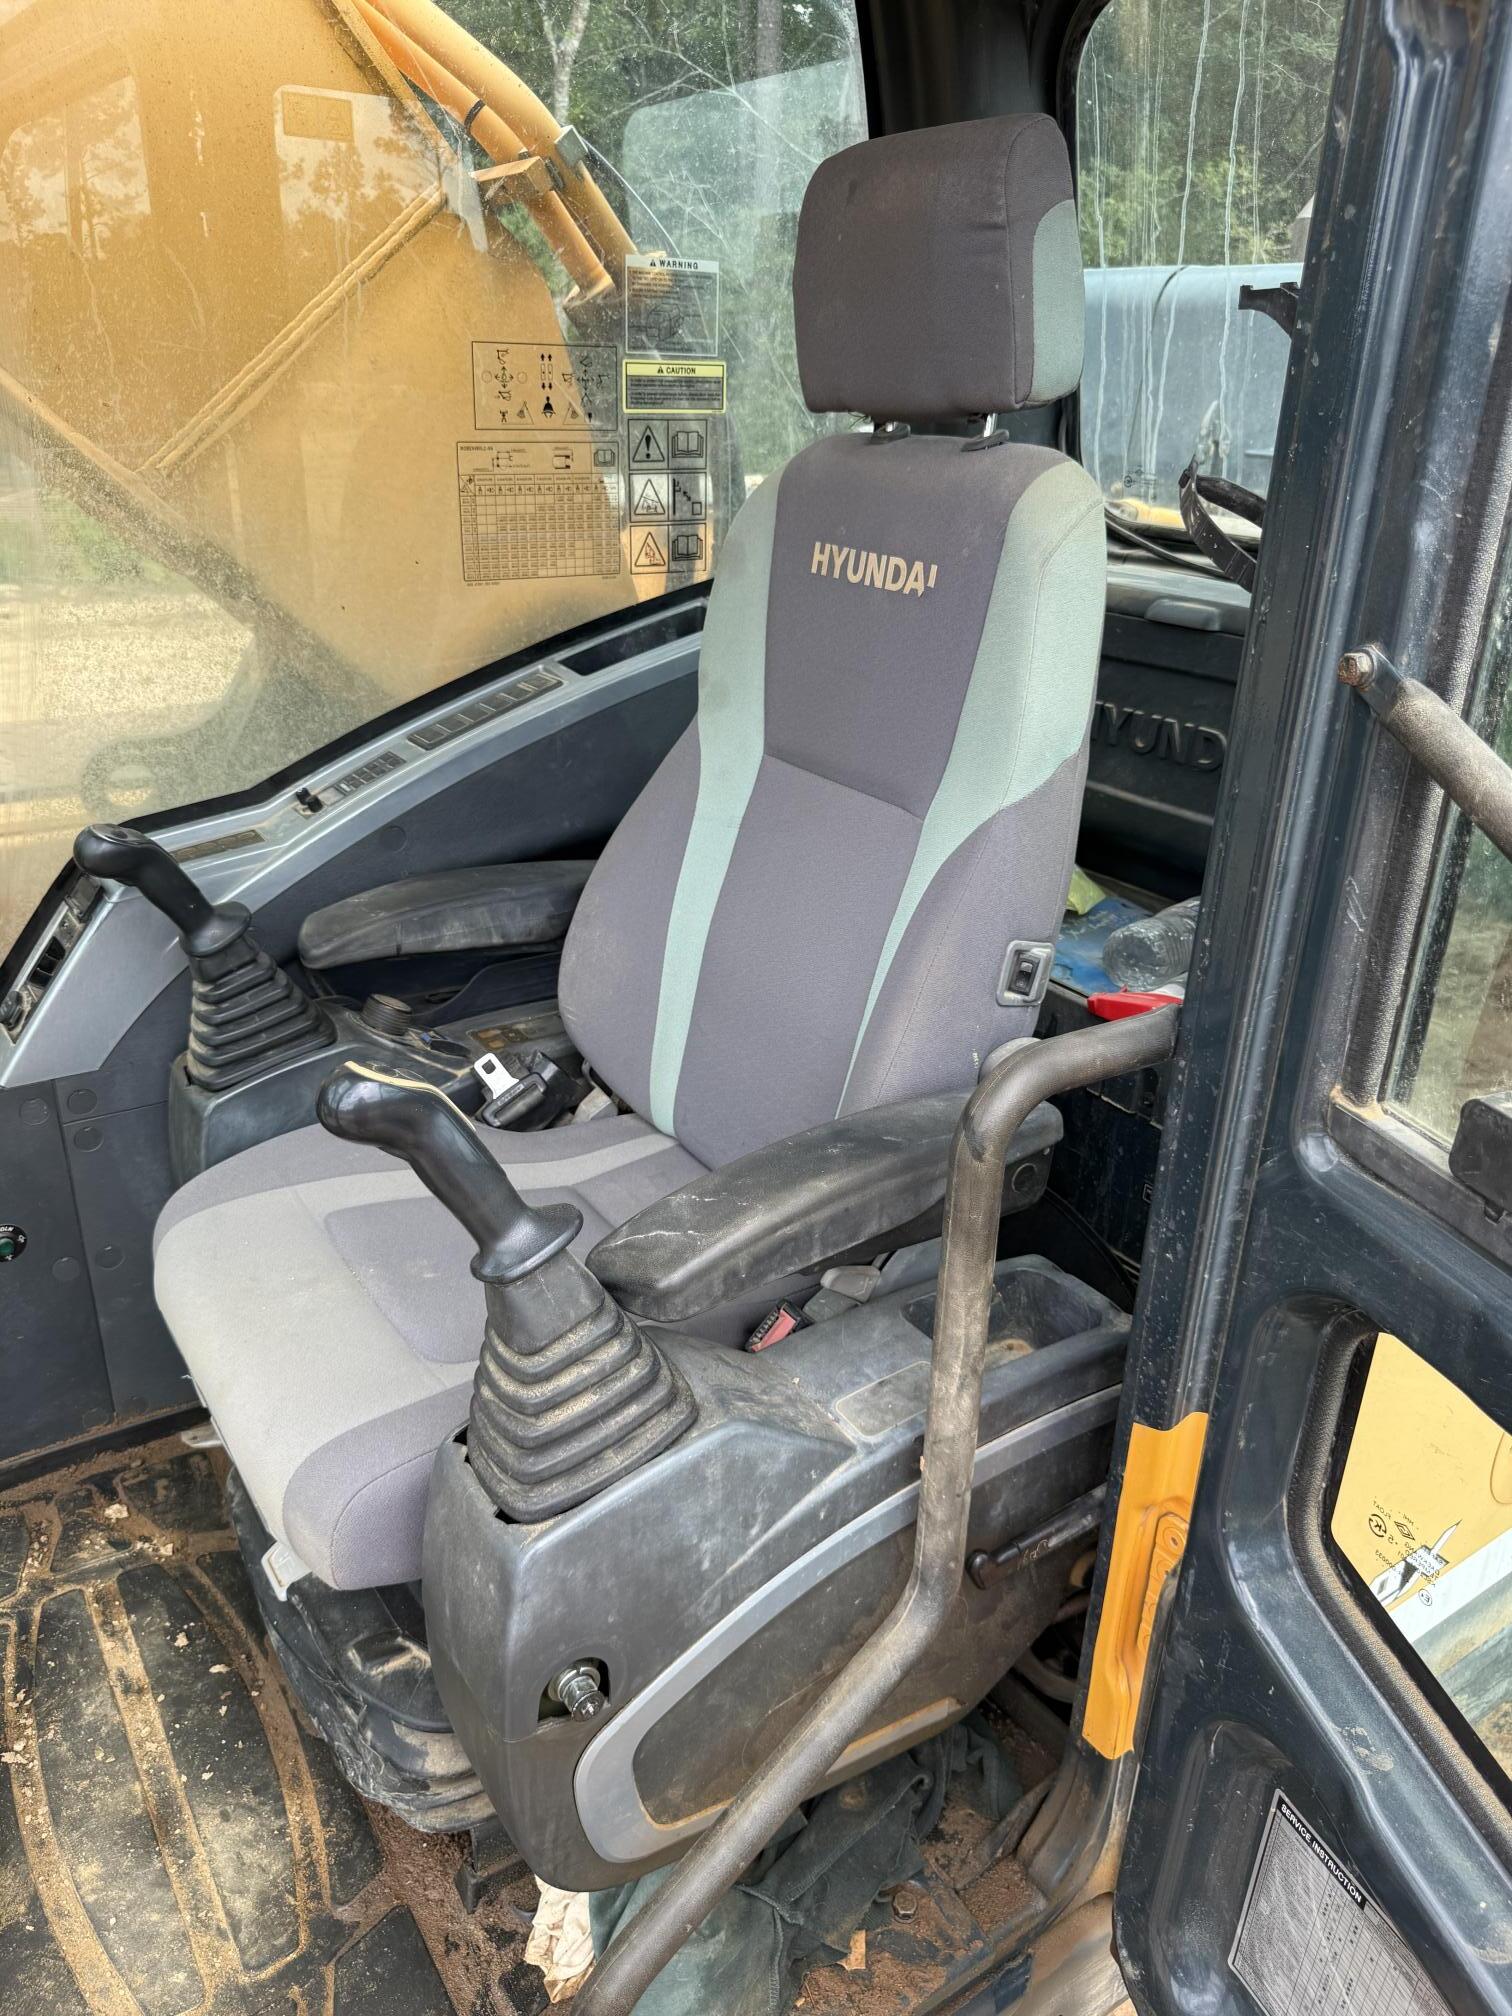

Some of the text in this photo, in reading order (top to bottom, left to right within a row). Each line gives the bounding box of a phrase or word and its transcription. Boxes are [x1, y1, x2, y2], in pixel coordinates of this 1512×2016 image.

[660, 260, 698, 270] WARNING
[666, 366, 696, 375] CAUTION
[810, 541, 938, 598] HYUNDAI
[1281, 1804, 1362, 1903] SERVICE INSTRUCTION
